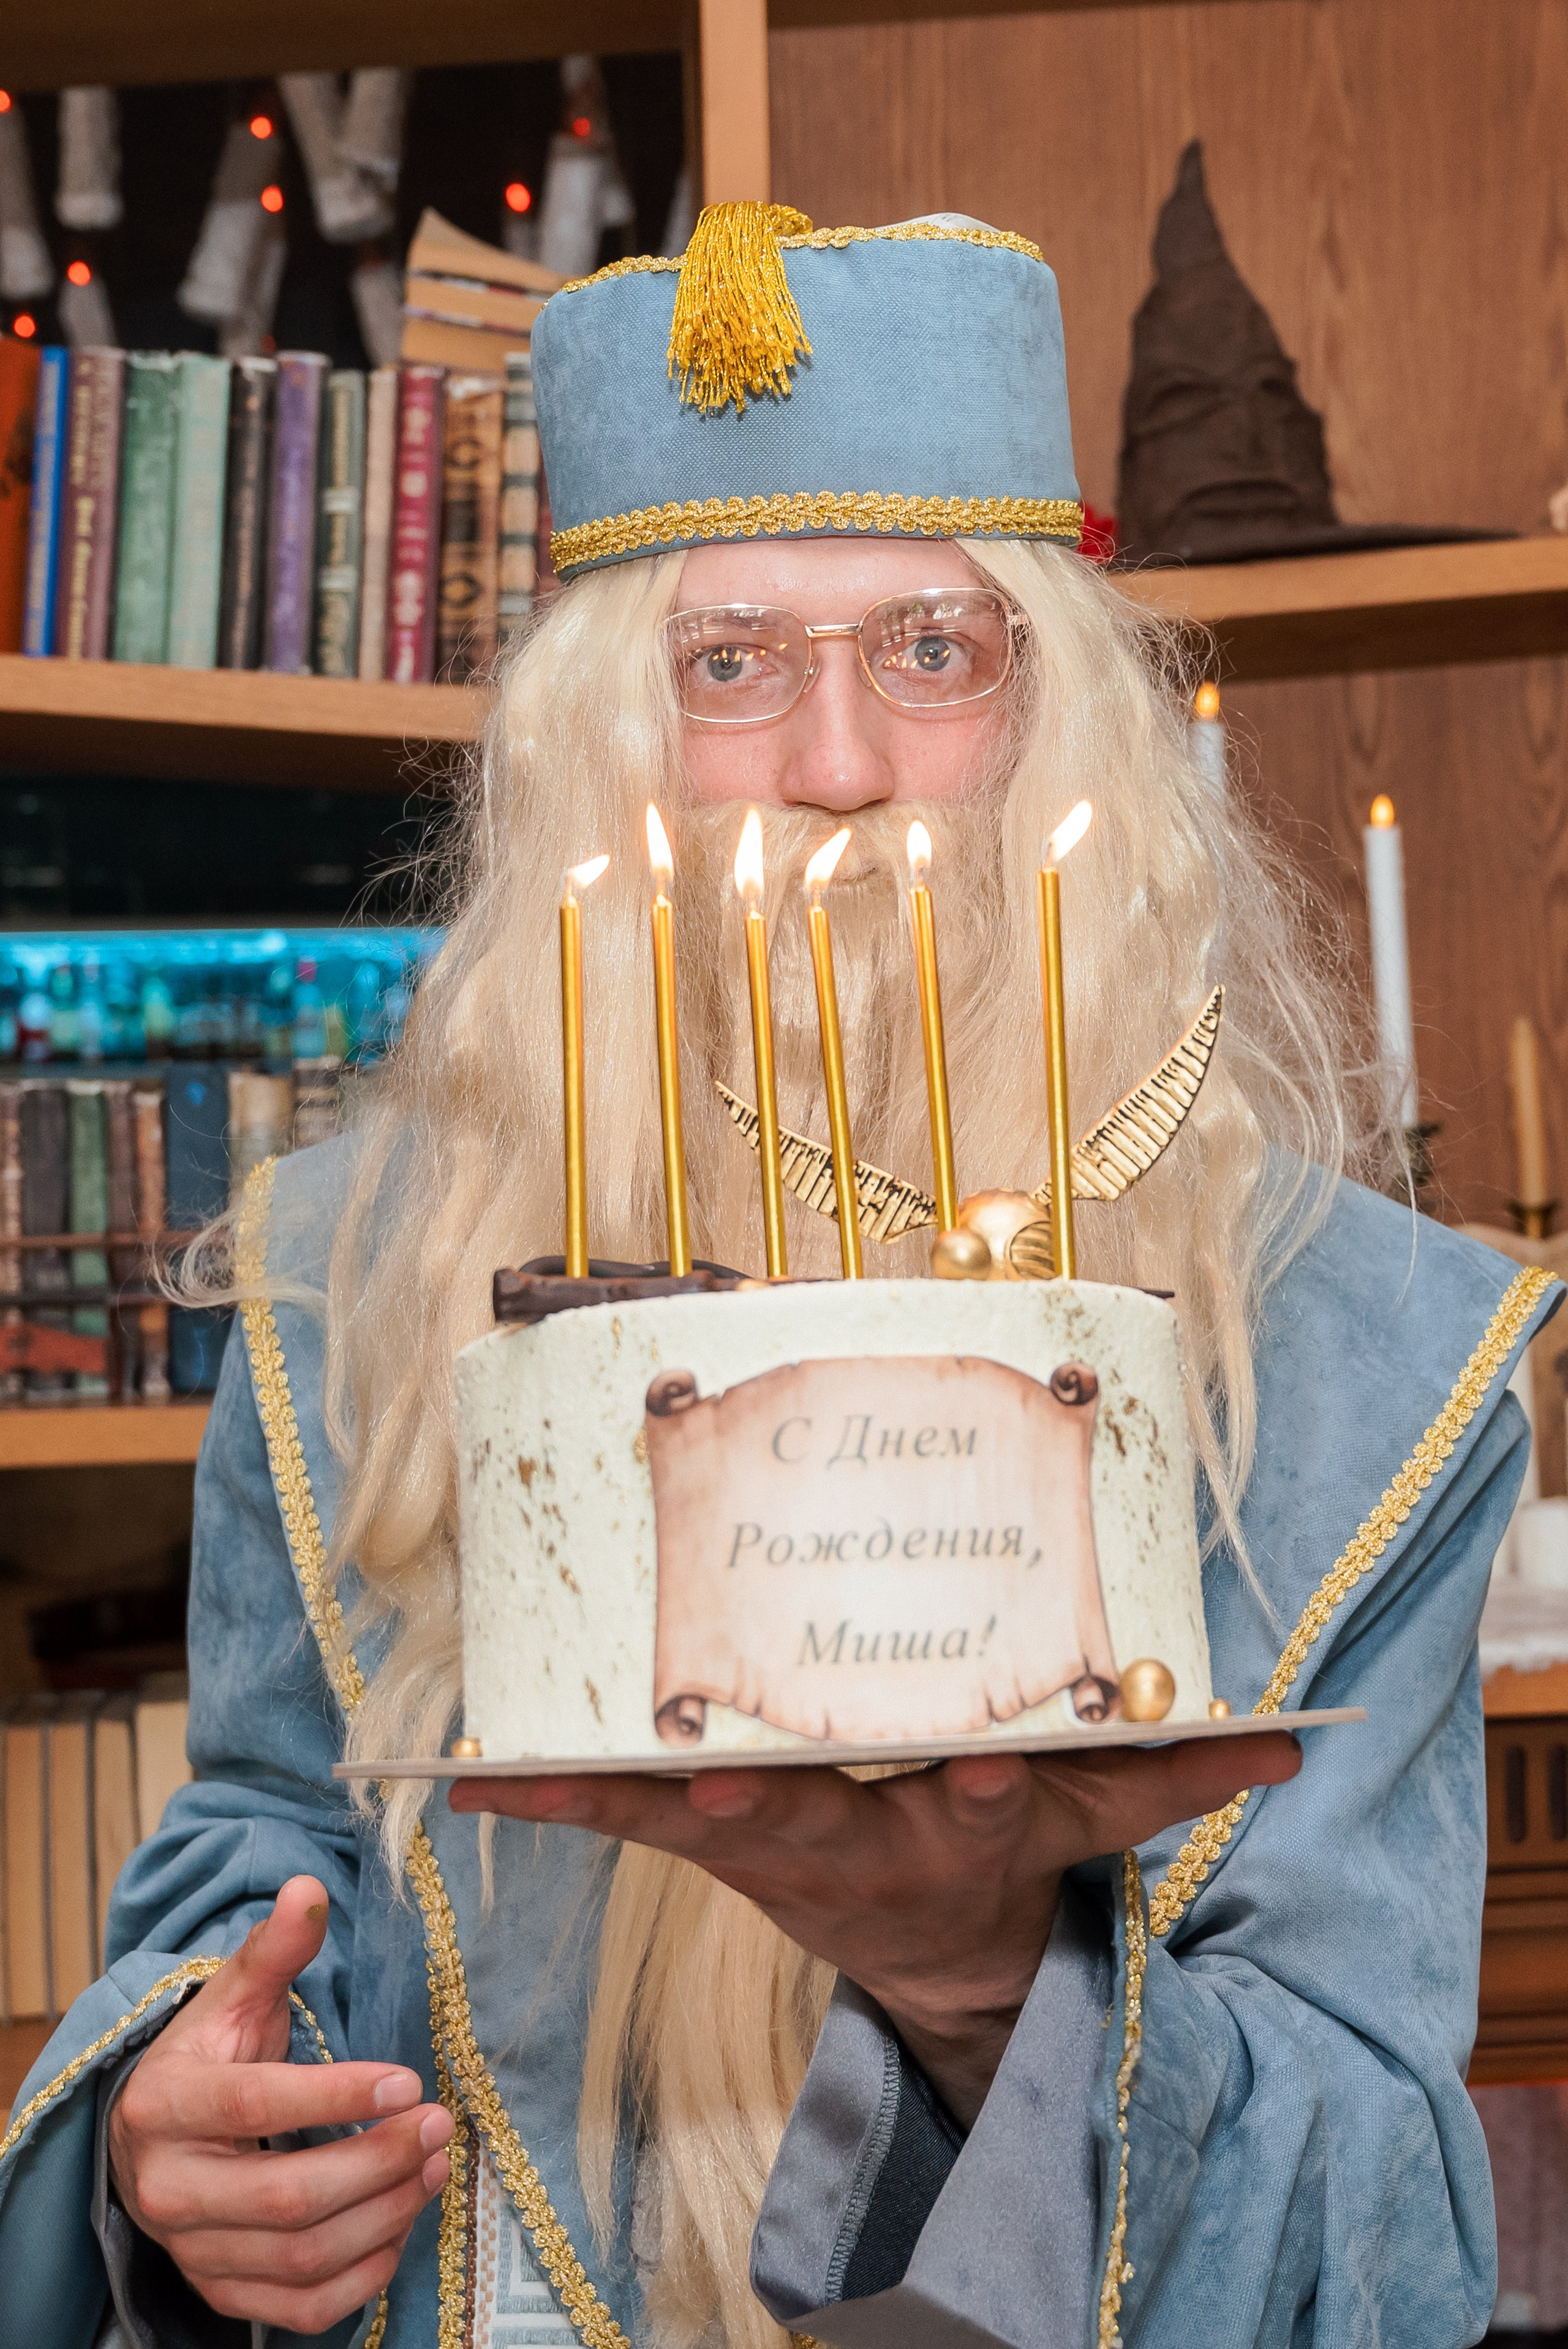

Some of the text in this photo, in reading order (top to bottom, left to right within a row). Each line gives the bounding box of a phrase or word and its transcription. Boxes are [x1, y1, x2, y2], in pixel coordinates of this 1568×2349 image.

[772, 1414, 978, 1468] С Днем
[727, 1518, 1043, 1568] Рождения,
[797, 1615, 997, 1666] Миша!
